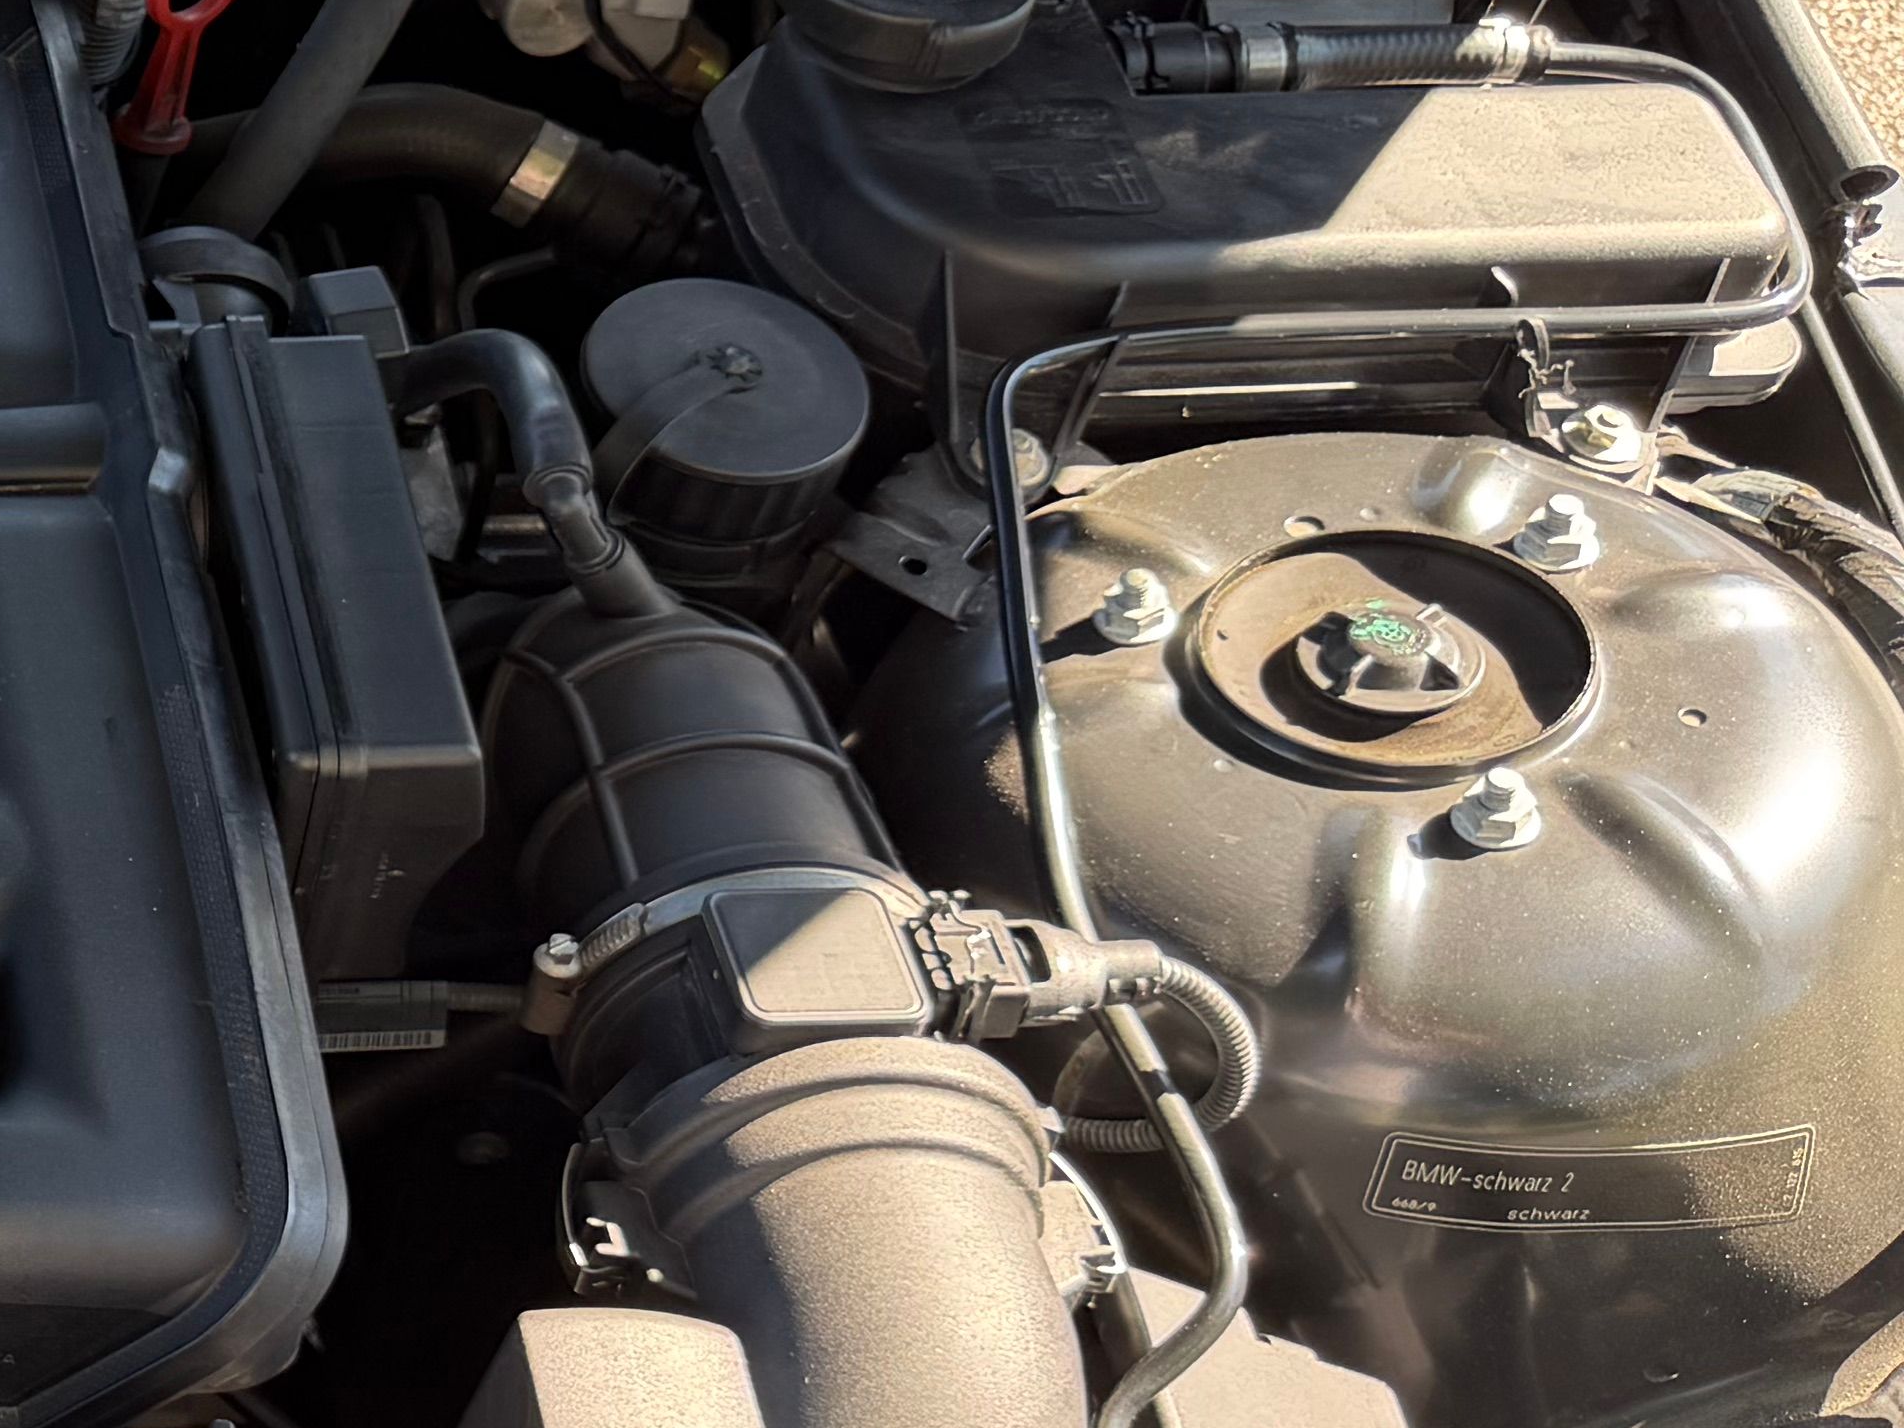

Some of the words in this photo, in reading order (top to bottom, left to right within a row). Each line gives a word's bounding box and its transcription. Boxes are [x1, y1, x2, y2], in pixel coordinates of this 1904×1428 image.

[1401, 1159, 1553, 1193] BMW-schwarz
[1560, 1172, 1575, 1193] 2
[1507, 1207, 1591, 1221] schwarz
